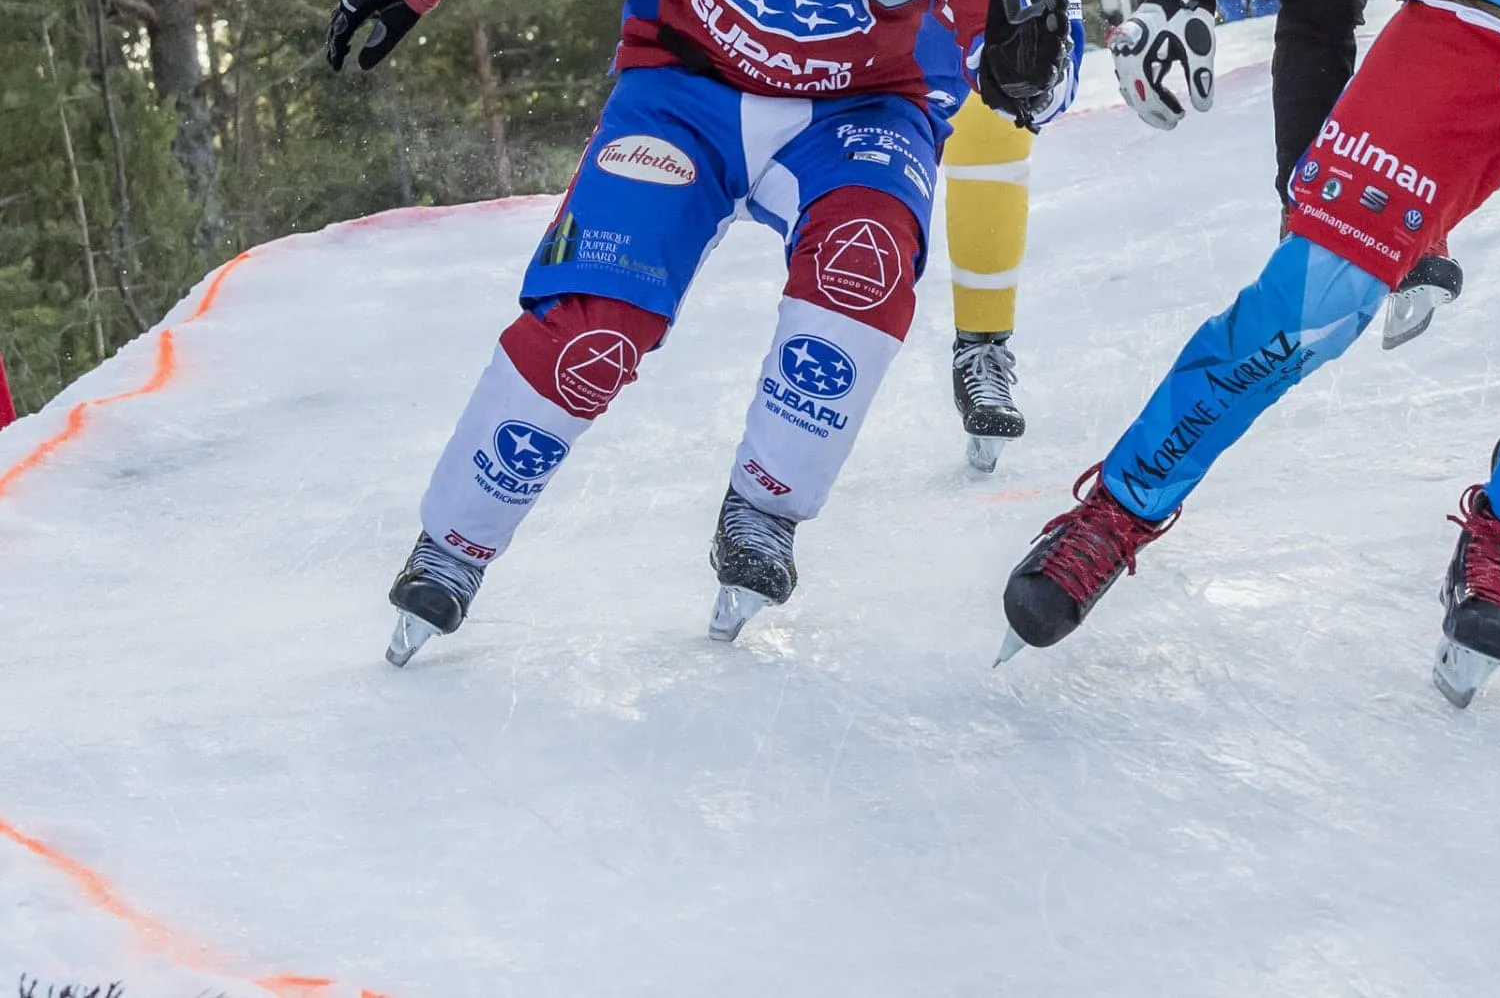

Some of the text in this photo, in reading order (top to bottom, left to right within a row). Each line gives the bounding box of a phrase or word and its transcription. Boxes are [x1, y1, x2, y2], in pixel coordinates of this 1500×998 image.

[599, 144, 696, 182] Tim Hortons
[1315, 119, 1437, 204] Pulman
[581, 228, 633, 245] BOURQUE
[762, 376, 848, 431] SUBARU
[765, 399, 830, 439] NEW RICHMOND
[474, 473, 494, 493] NEW
[743, 459, 792, 496] G-SW
[443, 529, 497, 561] G-SW
